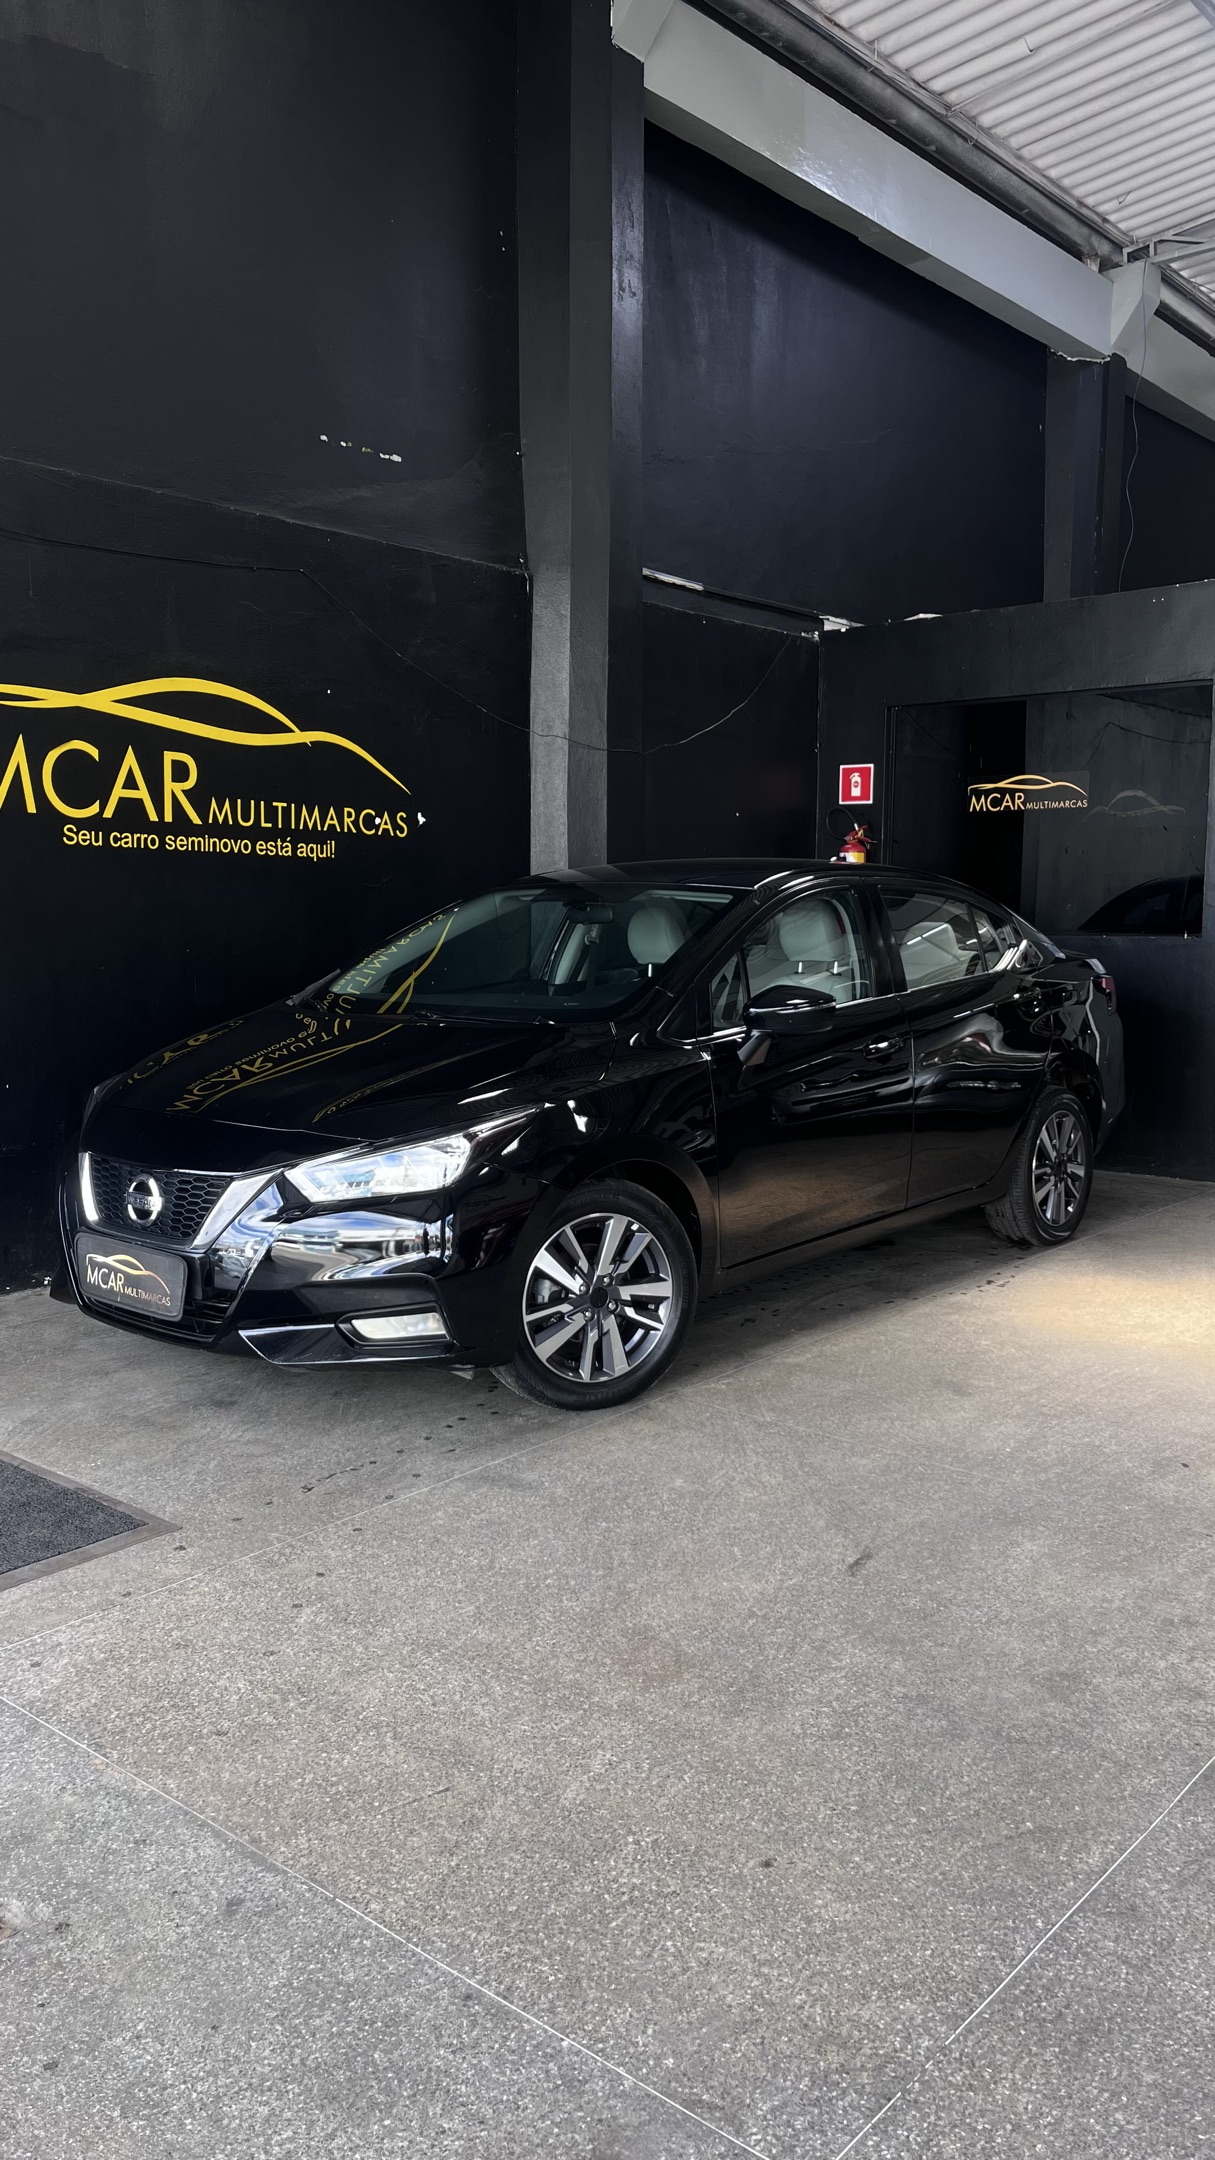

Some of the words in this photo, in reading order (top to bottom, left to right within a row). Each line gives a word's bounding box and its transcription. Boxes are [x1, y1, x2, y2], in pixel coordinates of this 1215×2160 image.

[208, 796, 409, 838] MULTIMARCAS
[969, 792, 1025, 812] MCAR
[1026, 799, 1088, 810] MULTIMARCAS
[62, 824, 104, 847] Seu
[109, 829, 160, 850] carro
[165, 831, 252, 855] seminovo
[255, 837, 293, 857] está
[296, 839, 336, 861] aqui!
[86, 1264, 125, 1293] MCAR
[124, 1285, 171, 1306] MULTIMARCAS
